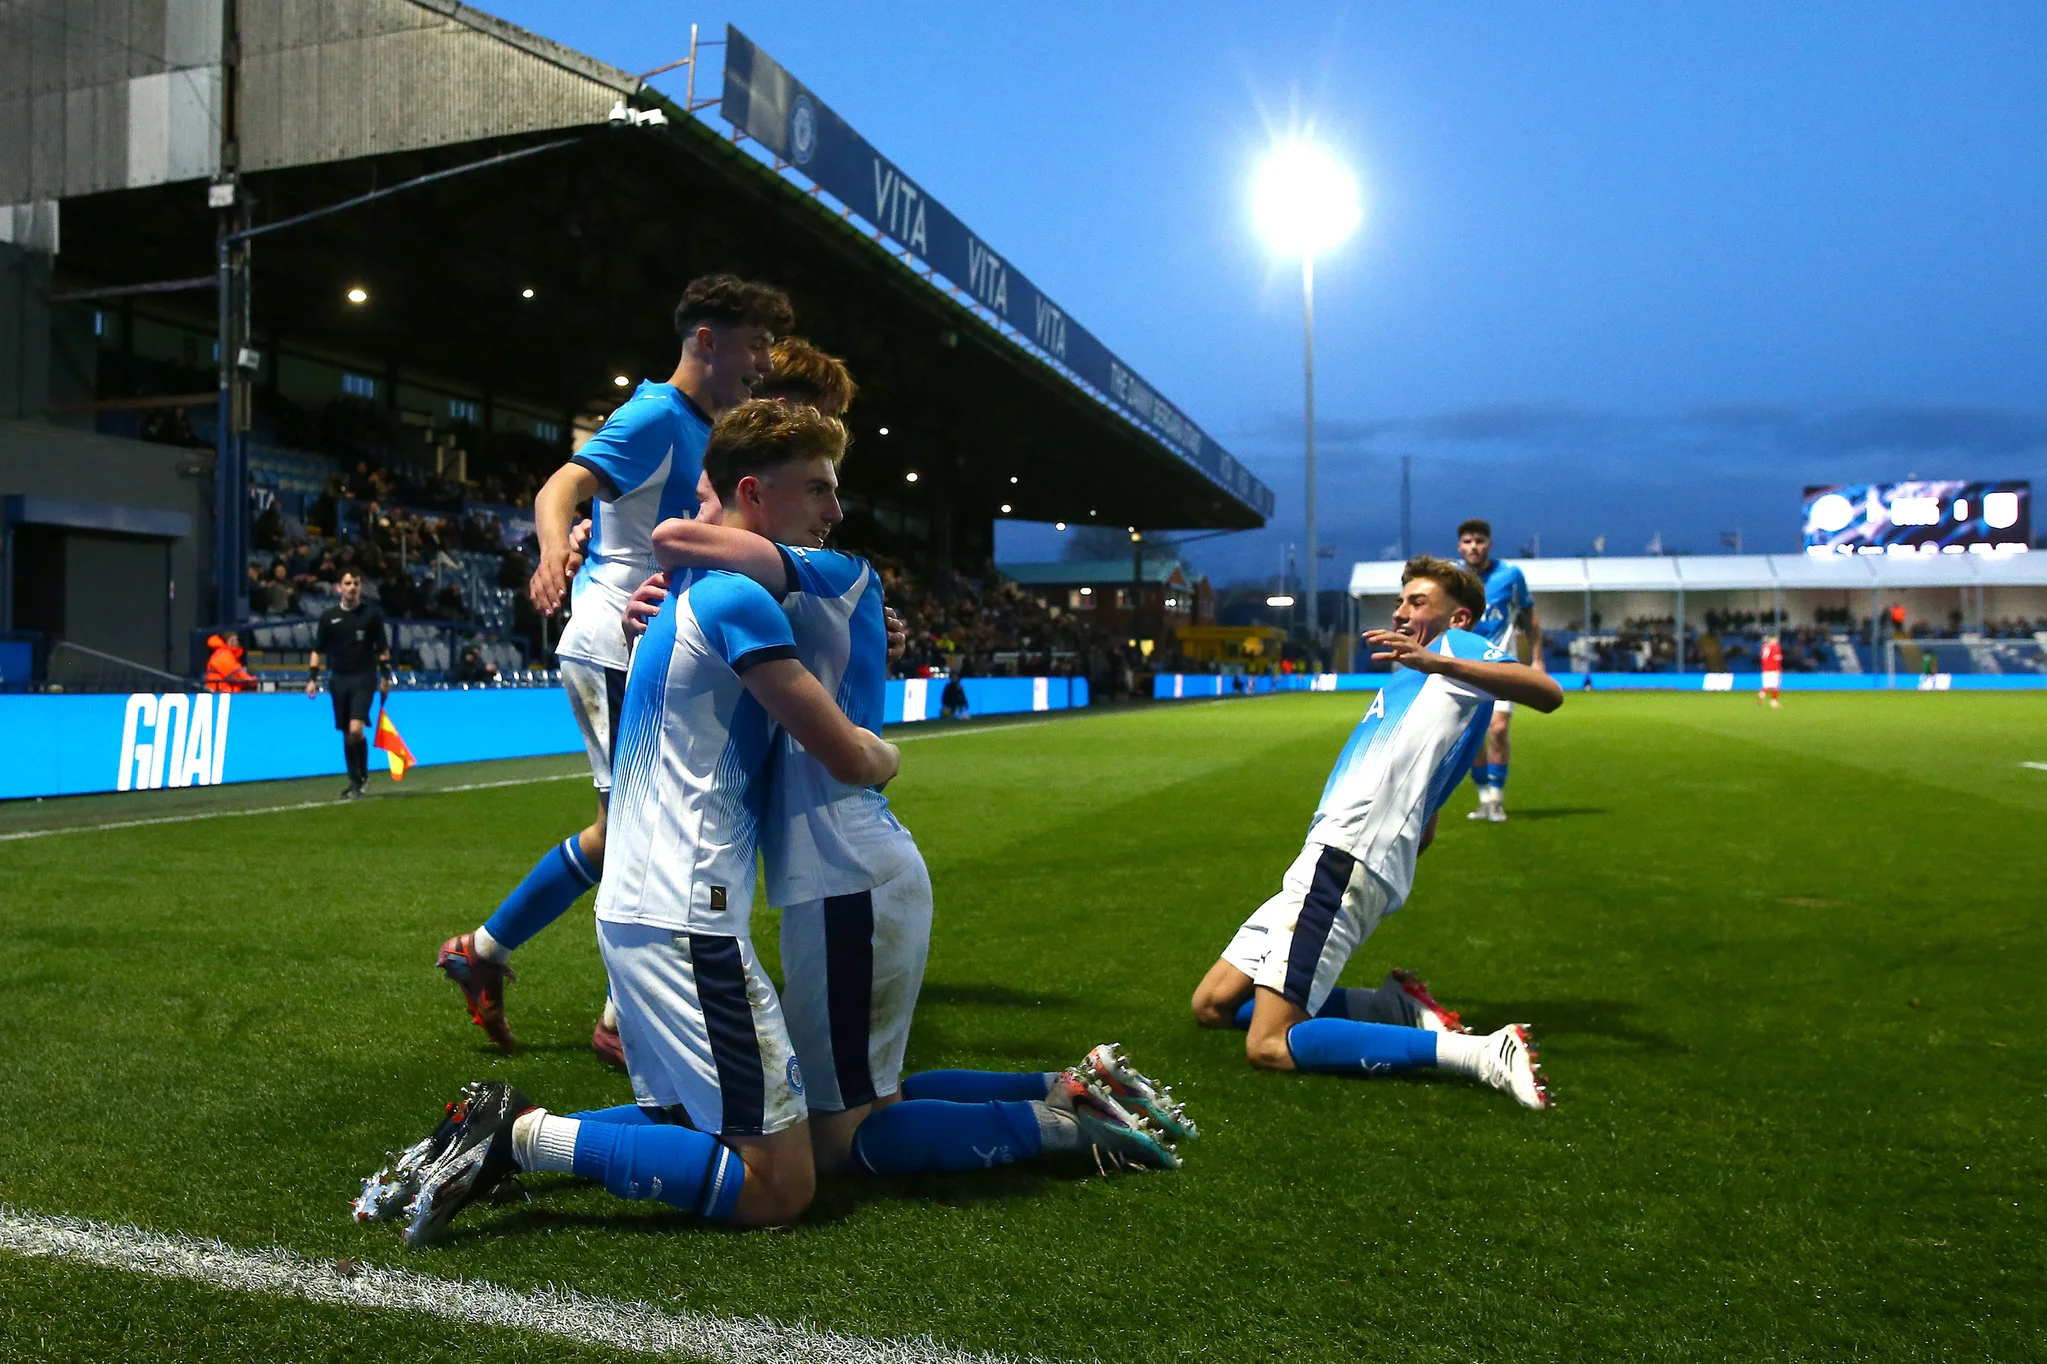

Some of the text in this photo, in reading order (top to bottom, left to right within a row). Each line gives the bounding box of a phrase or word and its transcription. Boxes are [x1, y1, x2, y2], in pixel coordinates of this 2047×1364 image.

[874, 158, 927, 256] VITA
[968, 237, 1008, 316] VITA
[1036, 294, 1066, 359] VITA
